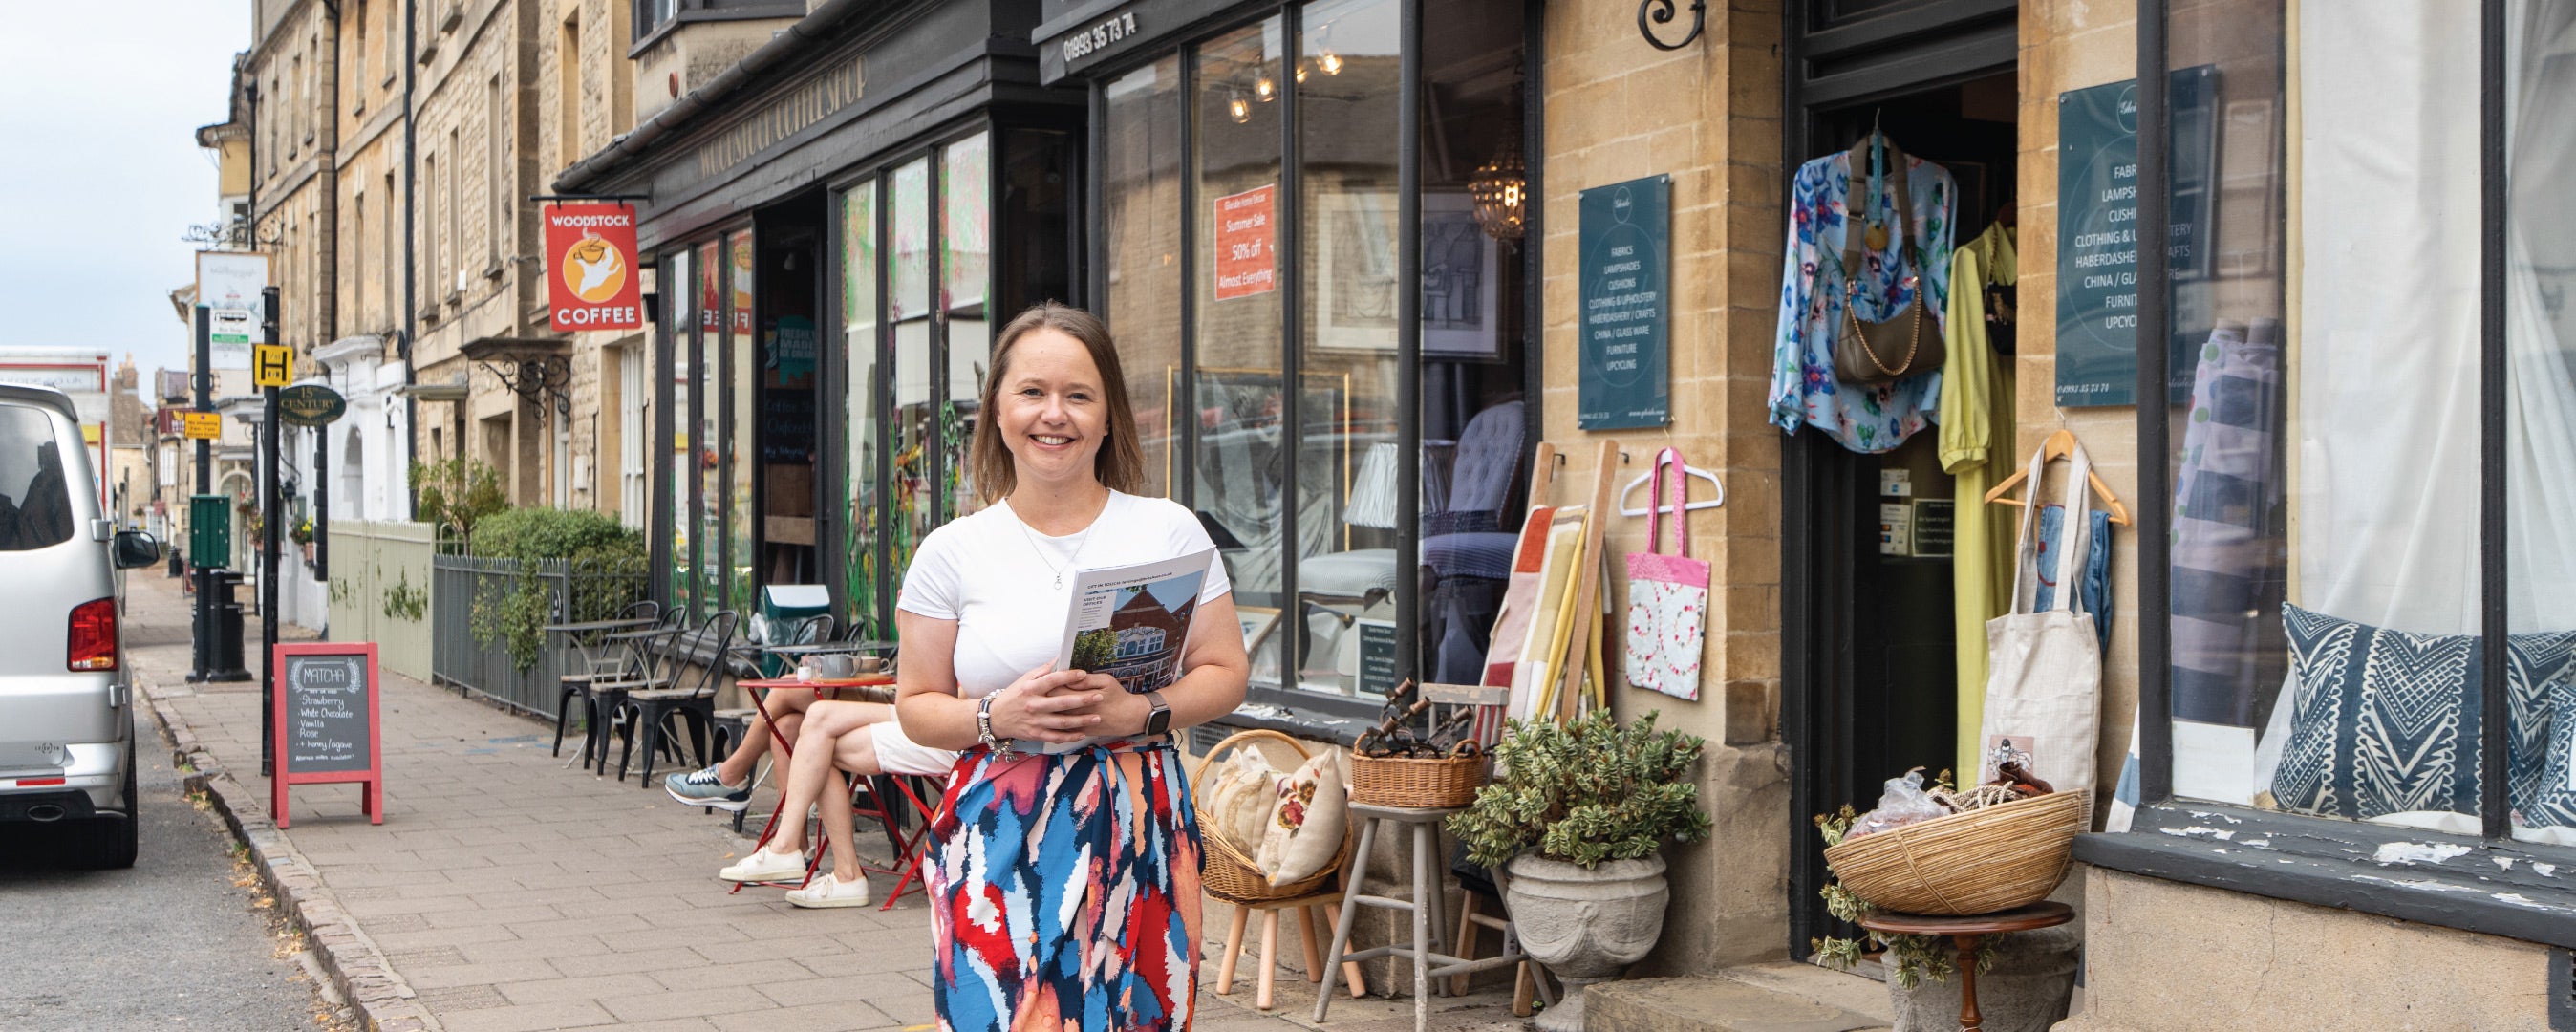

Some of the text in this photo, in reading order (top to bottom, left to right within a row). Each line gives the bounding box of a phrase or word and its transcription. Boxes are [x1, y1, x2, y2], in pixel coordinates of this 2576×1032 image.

[1063, 32, 1092, 62] 01993
[1093, 25, 1107, 49] 35
[1107, 17, 1122, 42] 73
[699, 54, 869, 179] WOODSTOCK COFFEE SHOP
[2114, 164, 2137, 179] FABR
[2102, 186, 2137, 203] LAMPSH
[552, 215, 630, 227] WOODSTOCK
[2109, 207, 2136, 223] CUSHI
[1226, 213, 1266, 233] Summer Sale
[2075, 231, 2120, 247] CLOTHING
[2122, 231, 2131, 242] &
[1232, 238, 1261, 261] 50% off
[1604, 260, 1641, 275] LAMPSHADES
[1218, 268, 1273, 289] Almost Everything
[1608, 278, 1637, 290] CUSHIONS
[2084, 274, 2113, 289] CHINA
[1589, 297, 1616, 309] CLOTHING
[1622, 291, 1657, 305] UPHOLSTERY
[2106, 294, 2137, 308] FURNIT
[558, 307, 635, 324] COFFEE
[1589, 311, 1631, 325] HABERDASHERY
[1635, 308, 1656, 320] CRAFTS
[1594, 330, 1611, 340] CHINA
[1616, 328, 1633, 337] GLASS
[1606, 343, 1637, 355] FURNITURE
[1606, 359, 1637, 371] UPCYCLING
[281, 398, 336, 409] CENTURY
[303, 667, 345, 685] MATCHA
[301, 694, 345, 711] Strawberry
[300, 707, 354, 719] White Chocolate
[300, 720, 324, 728] Vanilla
[299, 727, 319, 739] Rose
